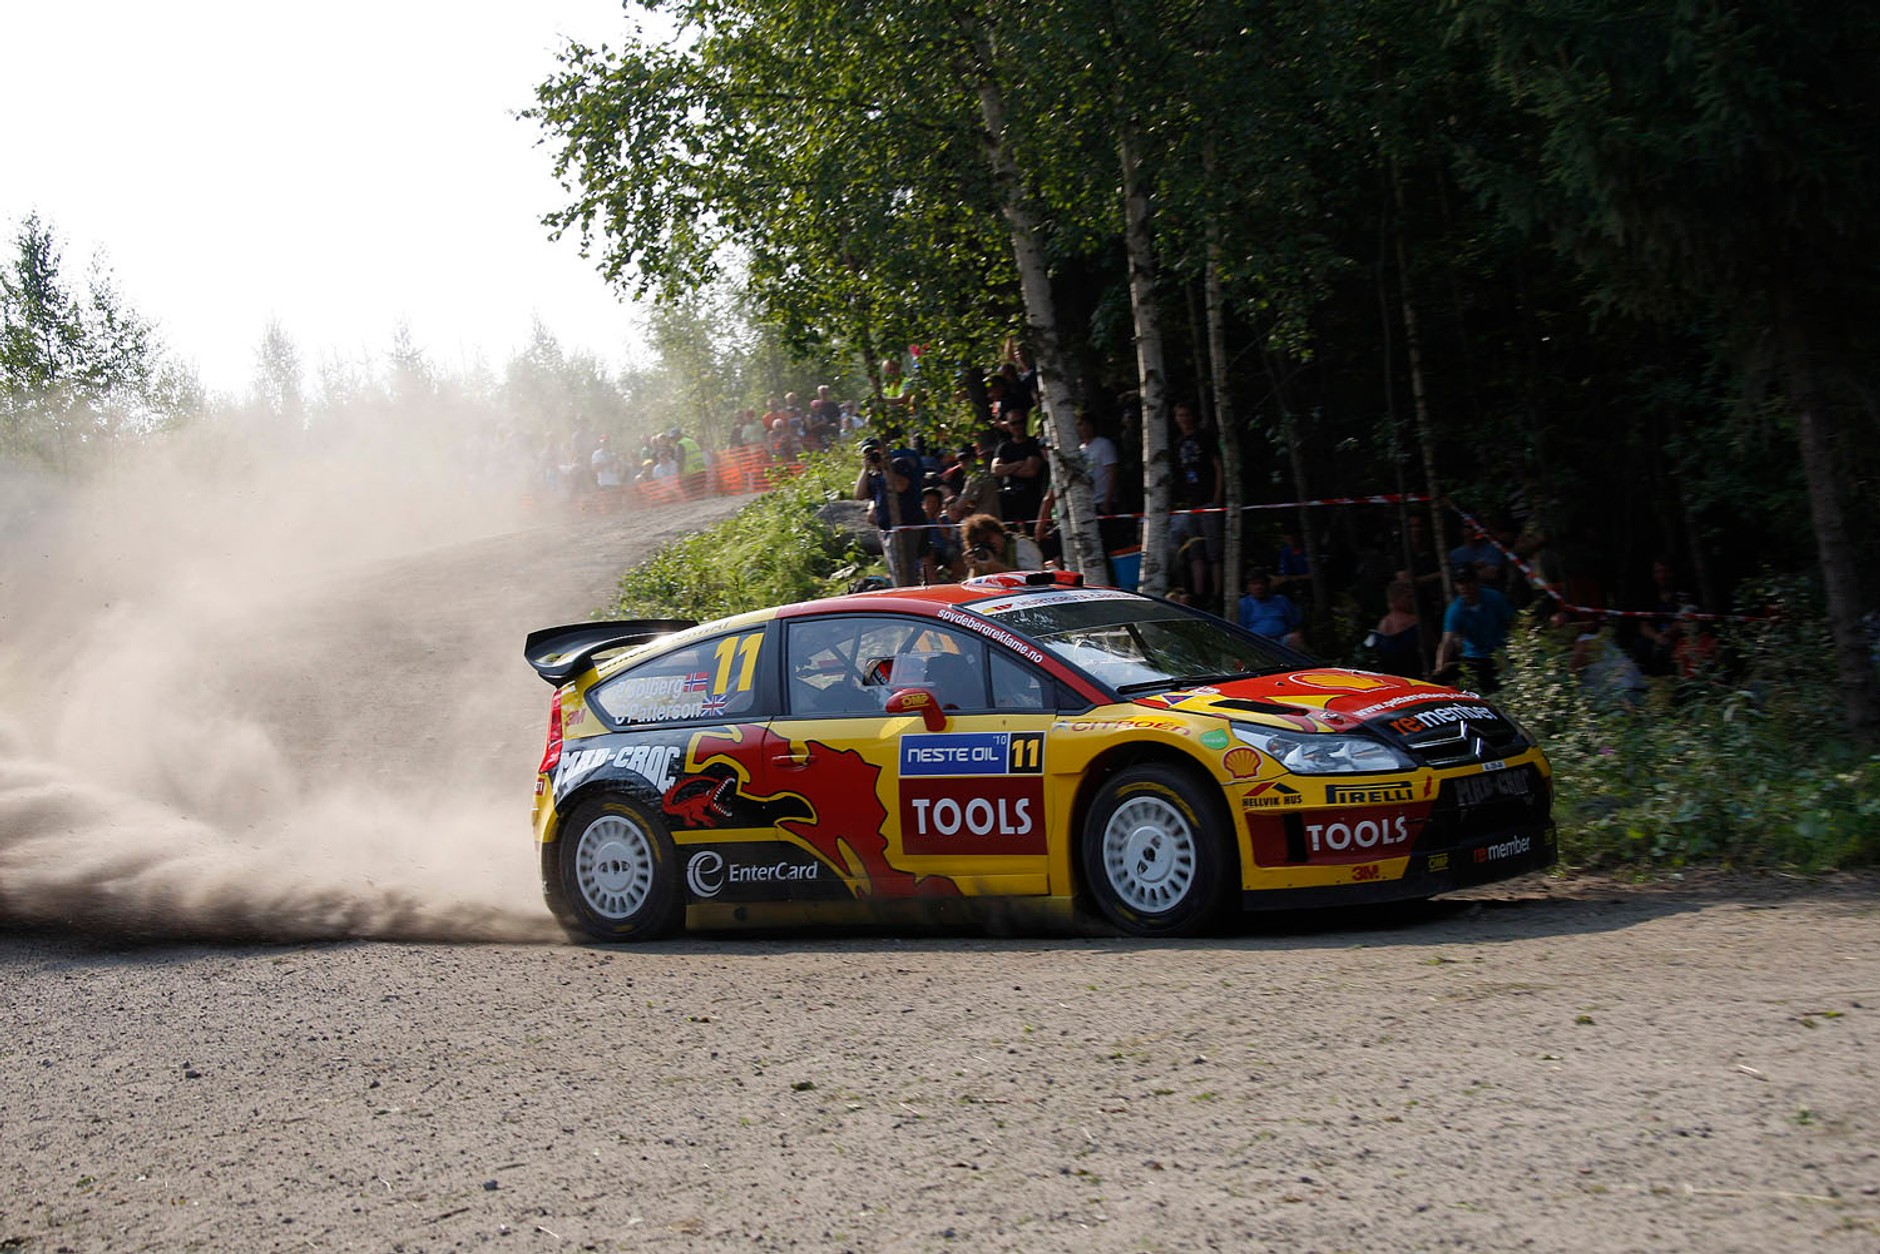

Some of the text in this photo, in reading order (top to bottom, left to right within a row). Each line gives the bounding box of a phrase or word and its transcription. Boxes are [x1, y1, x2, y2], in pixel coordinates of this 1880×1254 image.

[937, 607, 1043, 664] spydebergreklame.no
[714, 632, 765, 695] 11
[907, 746, 999, 763] NESTE OIL
[1012, 739, 1040, 768] 11
[552, 746, 681, 797] MAD-CROC
[1283, 794, 1303, 805] HUS
[1325, 781, 1414, 804] PIRELLI
[911, 798, 1033, 836] TOOLS
[1306, 815, 1408, 852] TOOLS
[728, 861, 819, 882] EnterCard
